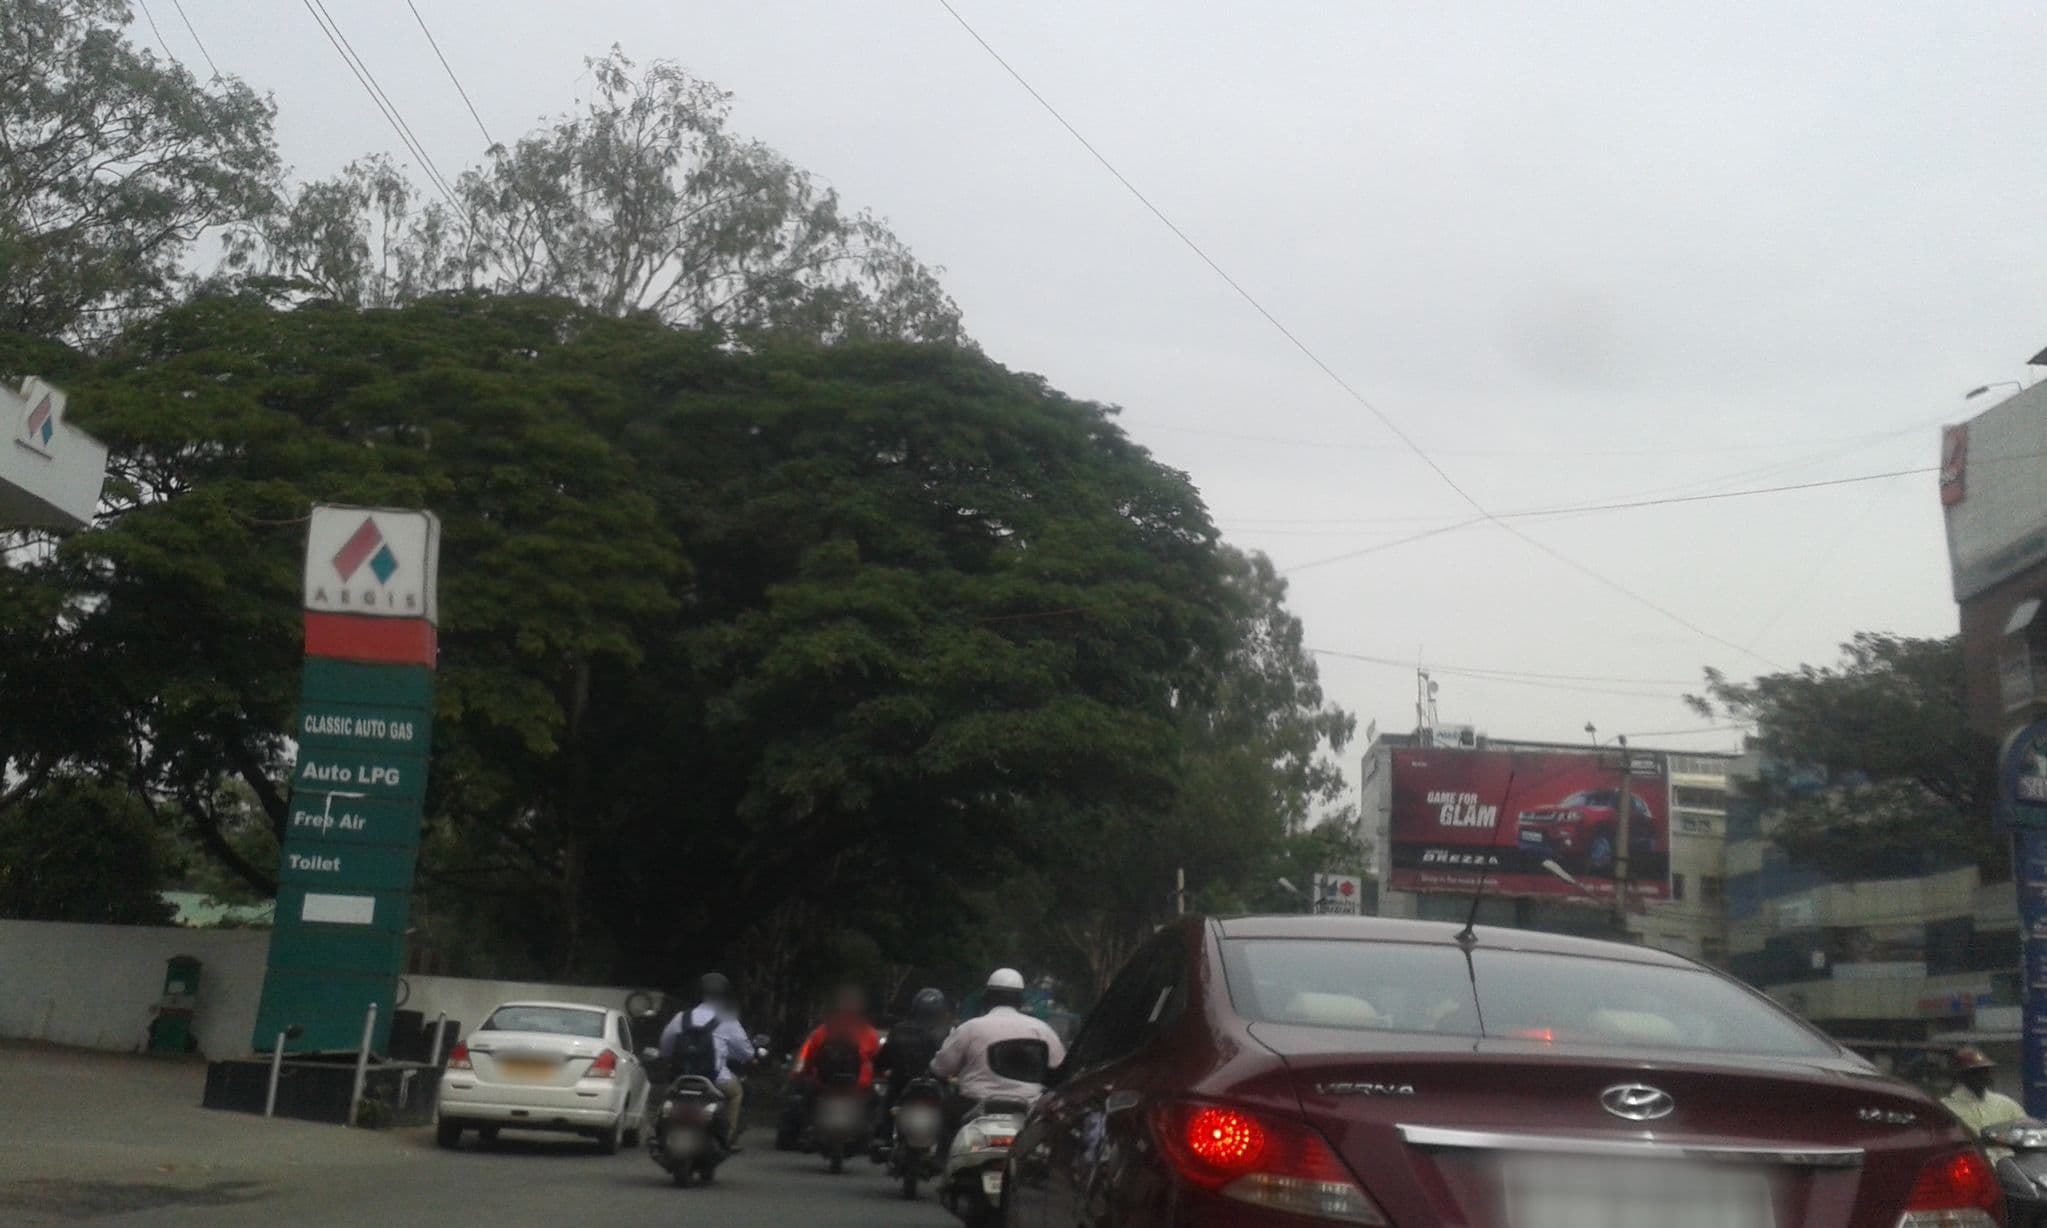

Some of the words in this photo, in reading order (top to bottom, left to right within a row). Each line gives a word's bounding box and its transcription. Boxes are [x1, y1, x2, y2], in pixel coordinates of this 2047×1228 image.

[314, 587, 416, 609] AEGIS
[304, 714, 352, 736] CLASSIC
[355, 718, 386, 739] AUTO
[390, 721, 413, 741] GAS
[302, 761, 352, 782] Auto
[358, 765, 400, 786] LPG
[1427, 791, 1456, 804] GAME
[1458, 792, 1478, 804] FOR
[339, 813, 367, 831] Air
[1439, 803, 1497, 828] GLAM
[289, 854, 341, 872] Toilet
[1315, 1083, 1415, 1097] VERNA
